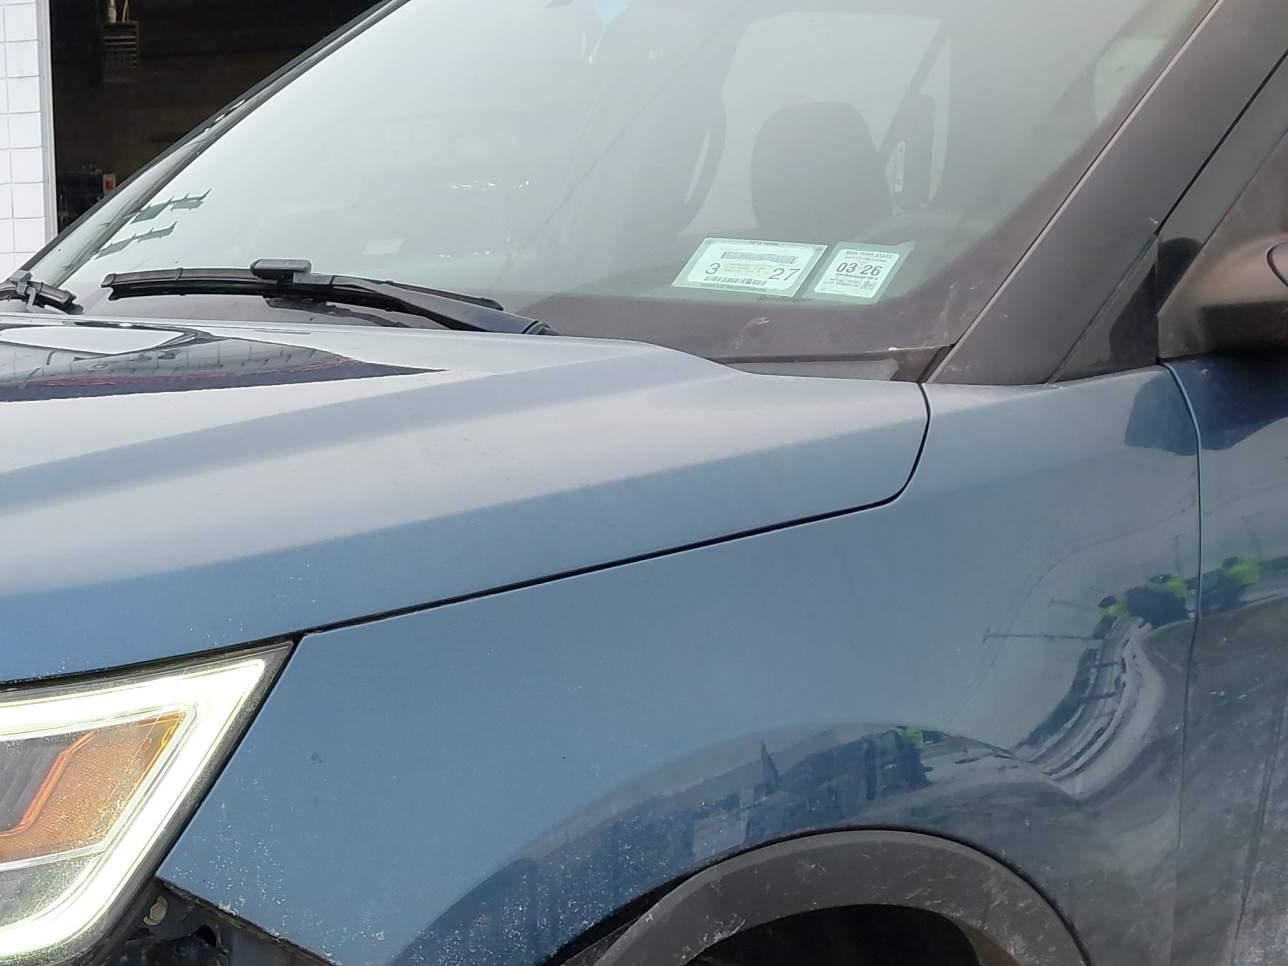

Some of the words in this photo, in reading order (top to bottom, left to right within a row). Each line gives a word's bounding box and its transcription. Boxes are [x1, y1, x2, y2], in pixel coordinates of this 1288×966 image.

[705, 262, 721, 275] 3
[768, 267, 801, 282] 27
[836, 262, 858, 273] 03
[859, 264, 883, 276] 26
